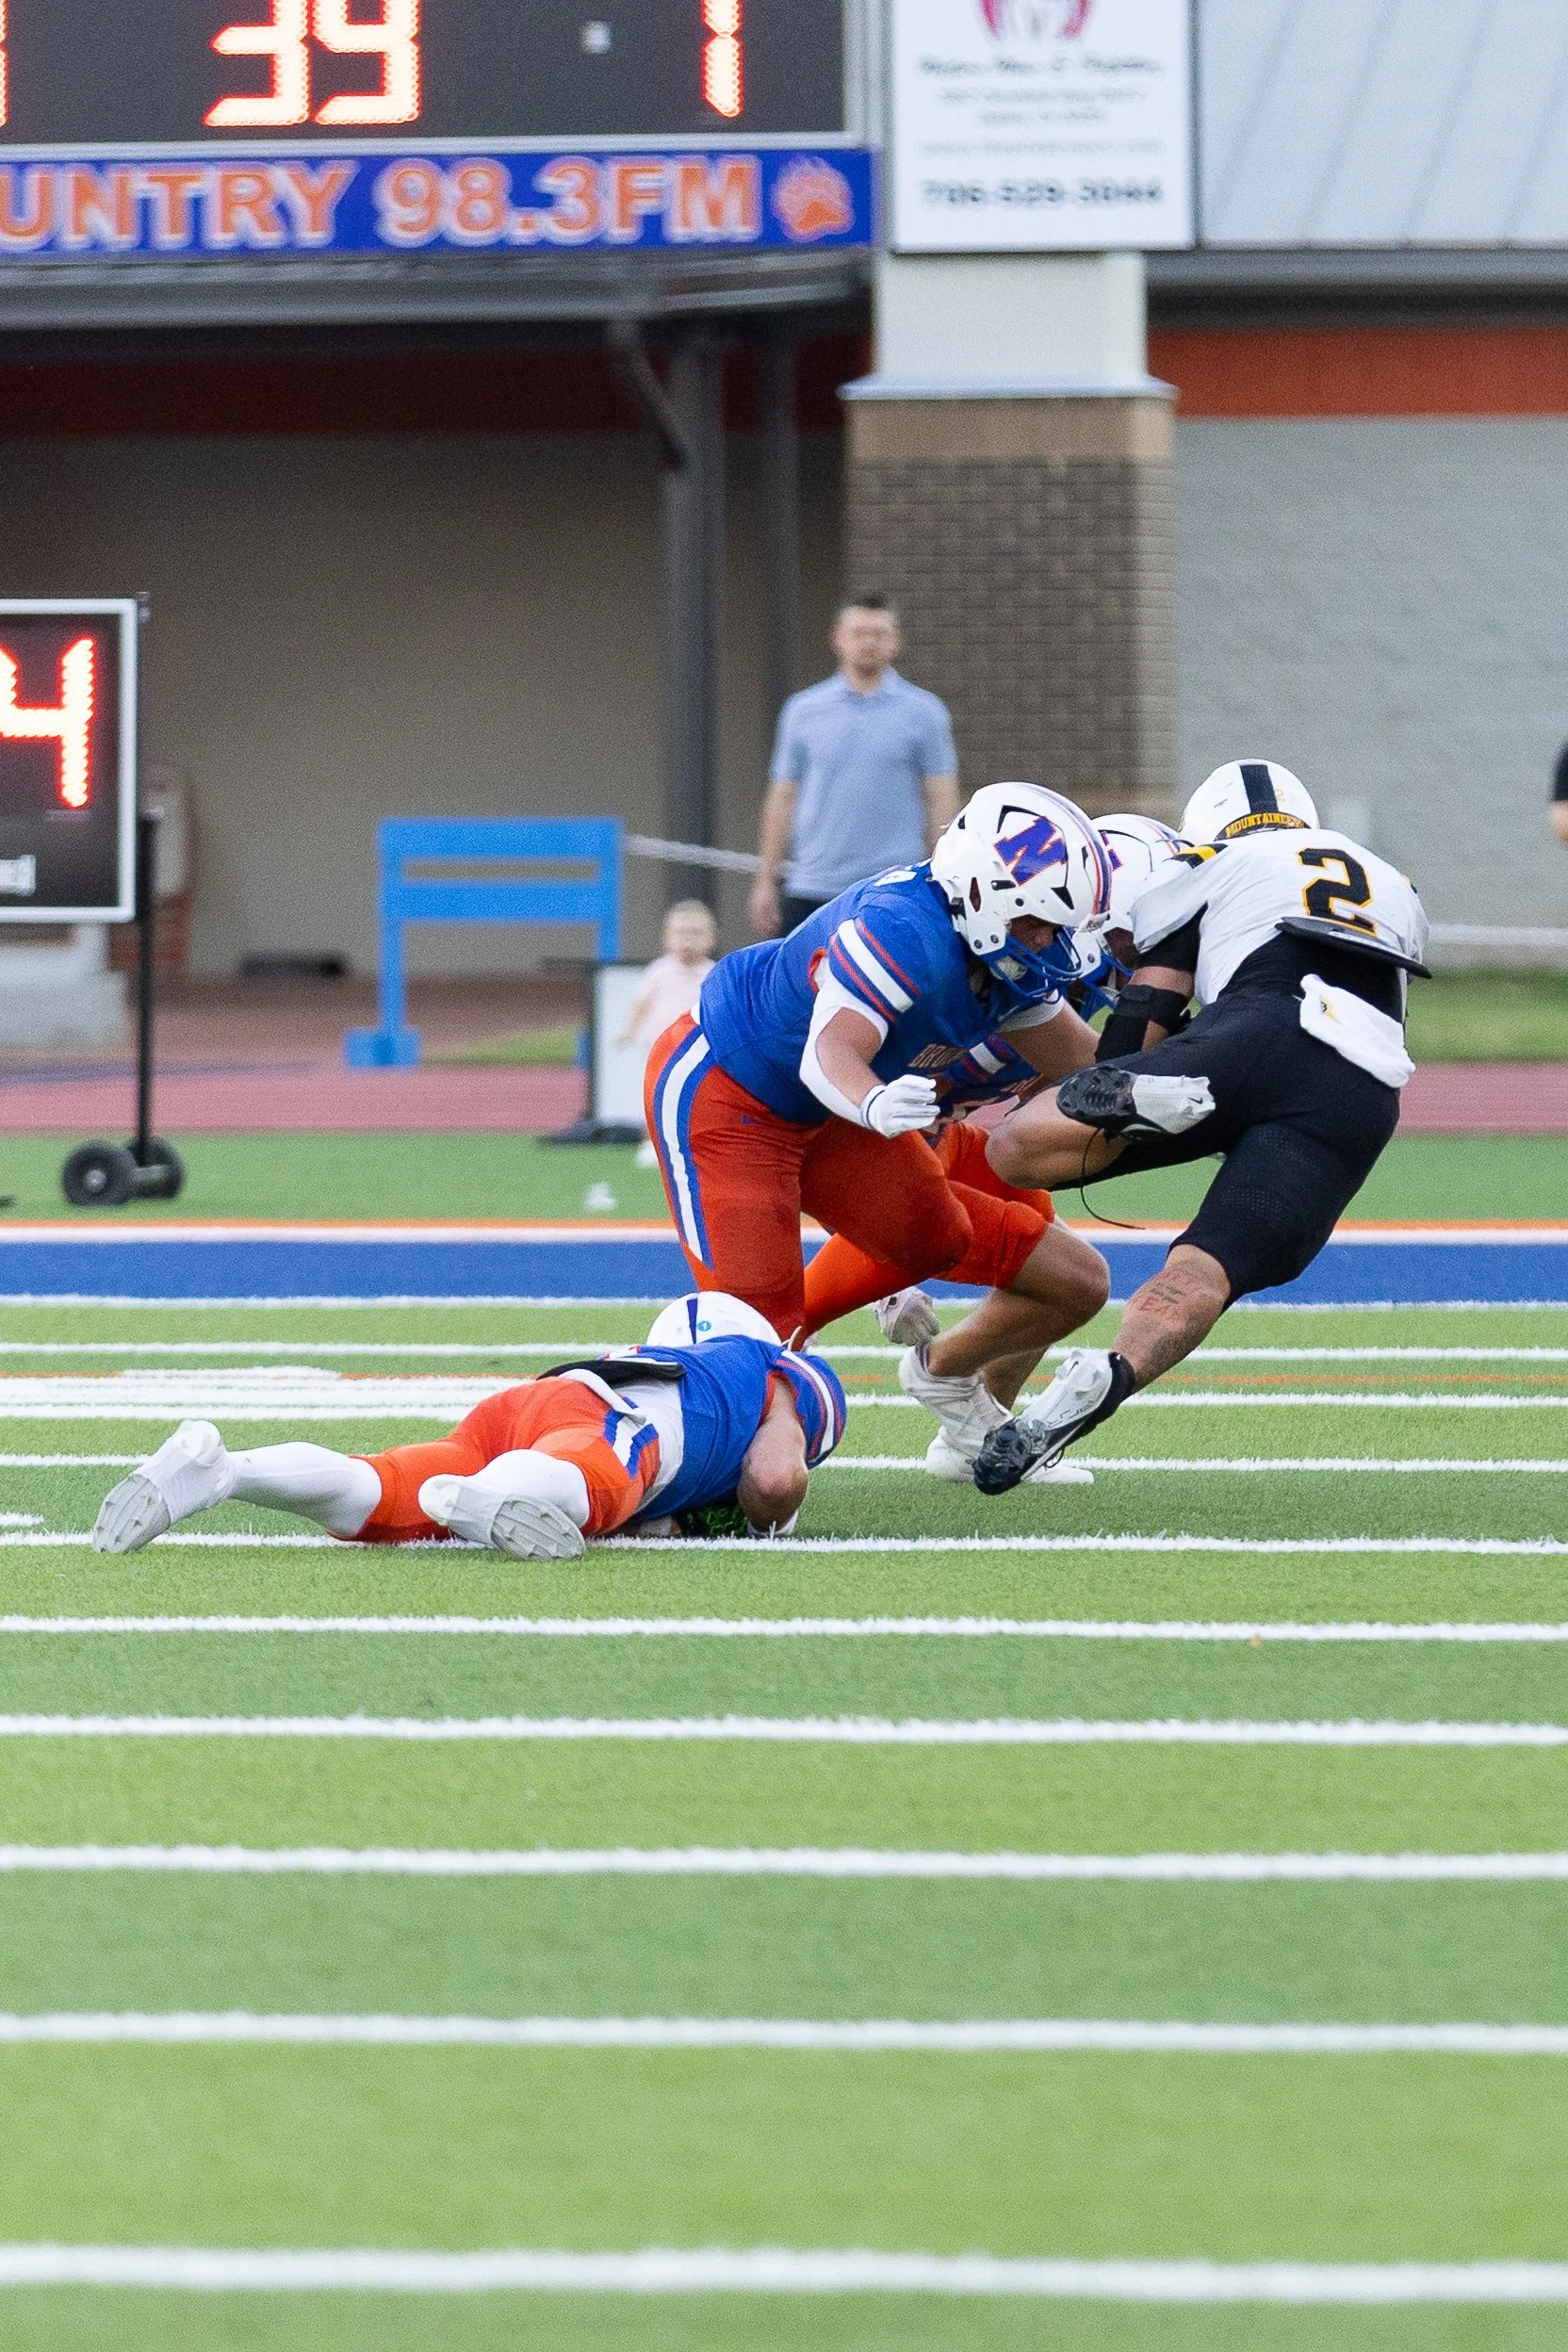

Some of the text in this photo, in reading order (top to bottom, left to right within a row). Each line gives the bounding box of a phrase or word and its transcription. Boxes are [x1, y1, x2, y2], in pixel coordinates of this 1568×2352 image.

[203, 0, 420, 126] 39
[375, 155, 761, 248] 98.3FM
[992, 816, 1069, 887] N
[1297, 847, 1379, 939] 2
